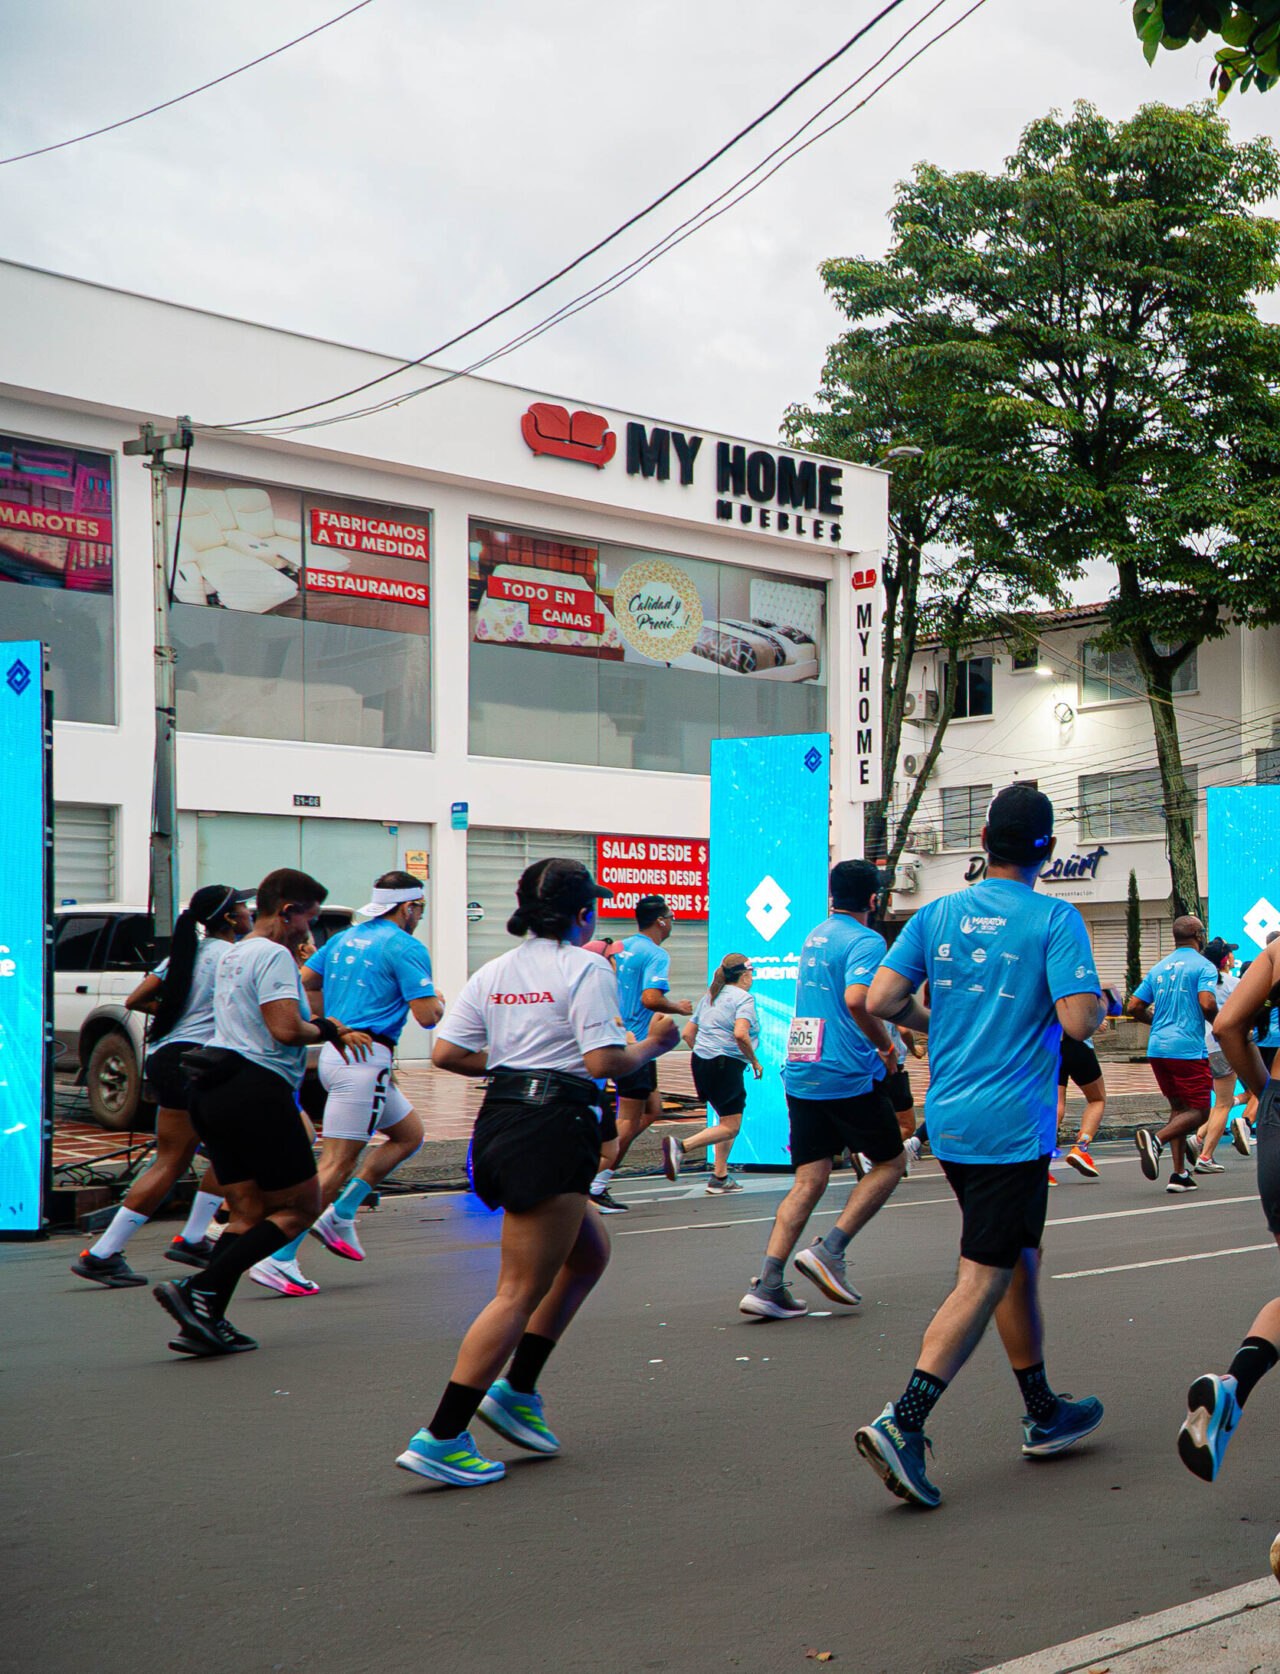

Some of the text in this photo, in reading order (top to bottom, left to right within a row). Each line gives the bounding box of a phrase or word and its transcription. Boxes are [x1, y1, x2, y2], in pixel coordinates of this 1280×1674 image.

[626, 421, 845, 516] MY HOME
[319, 512, 426, 542] FABRICAMOS
[716, 499, 843, 542] MUEBLES
[317, 529, 427, 559] A TU MEDIDA
[306, 571, 426, 601] RESTAURAMOS
[502, 582, 576, 605] TODO EN
[628, 593, 681, 615] Calidad y
[542, 609, 592, 628] CAMAS
[856, 603, 872, 785] MY HOME
[602, 841, 707, 864] SALAS DESDE $
[602, 867, 702, 886] COMEDORES DESDE
[695, 895, 702, 912] $
[489, 992, 555, 1005] HONDA
[881, 1419, 906, 1450] HOKA
